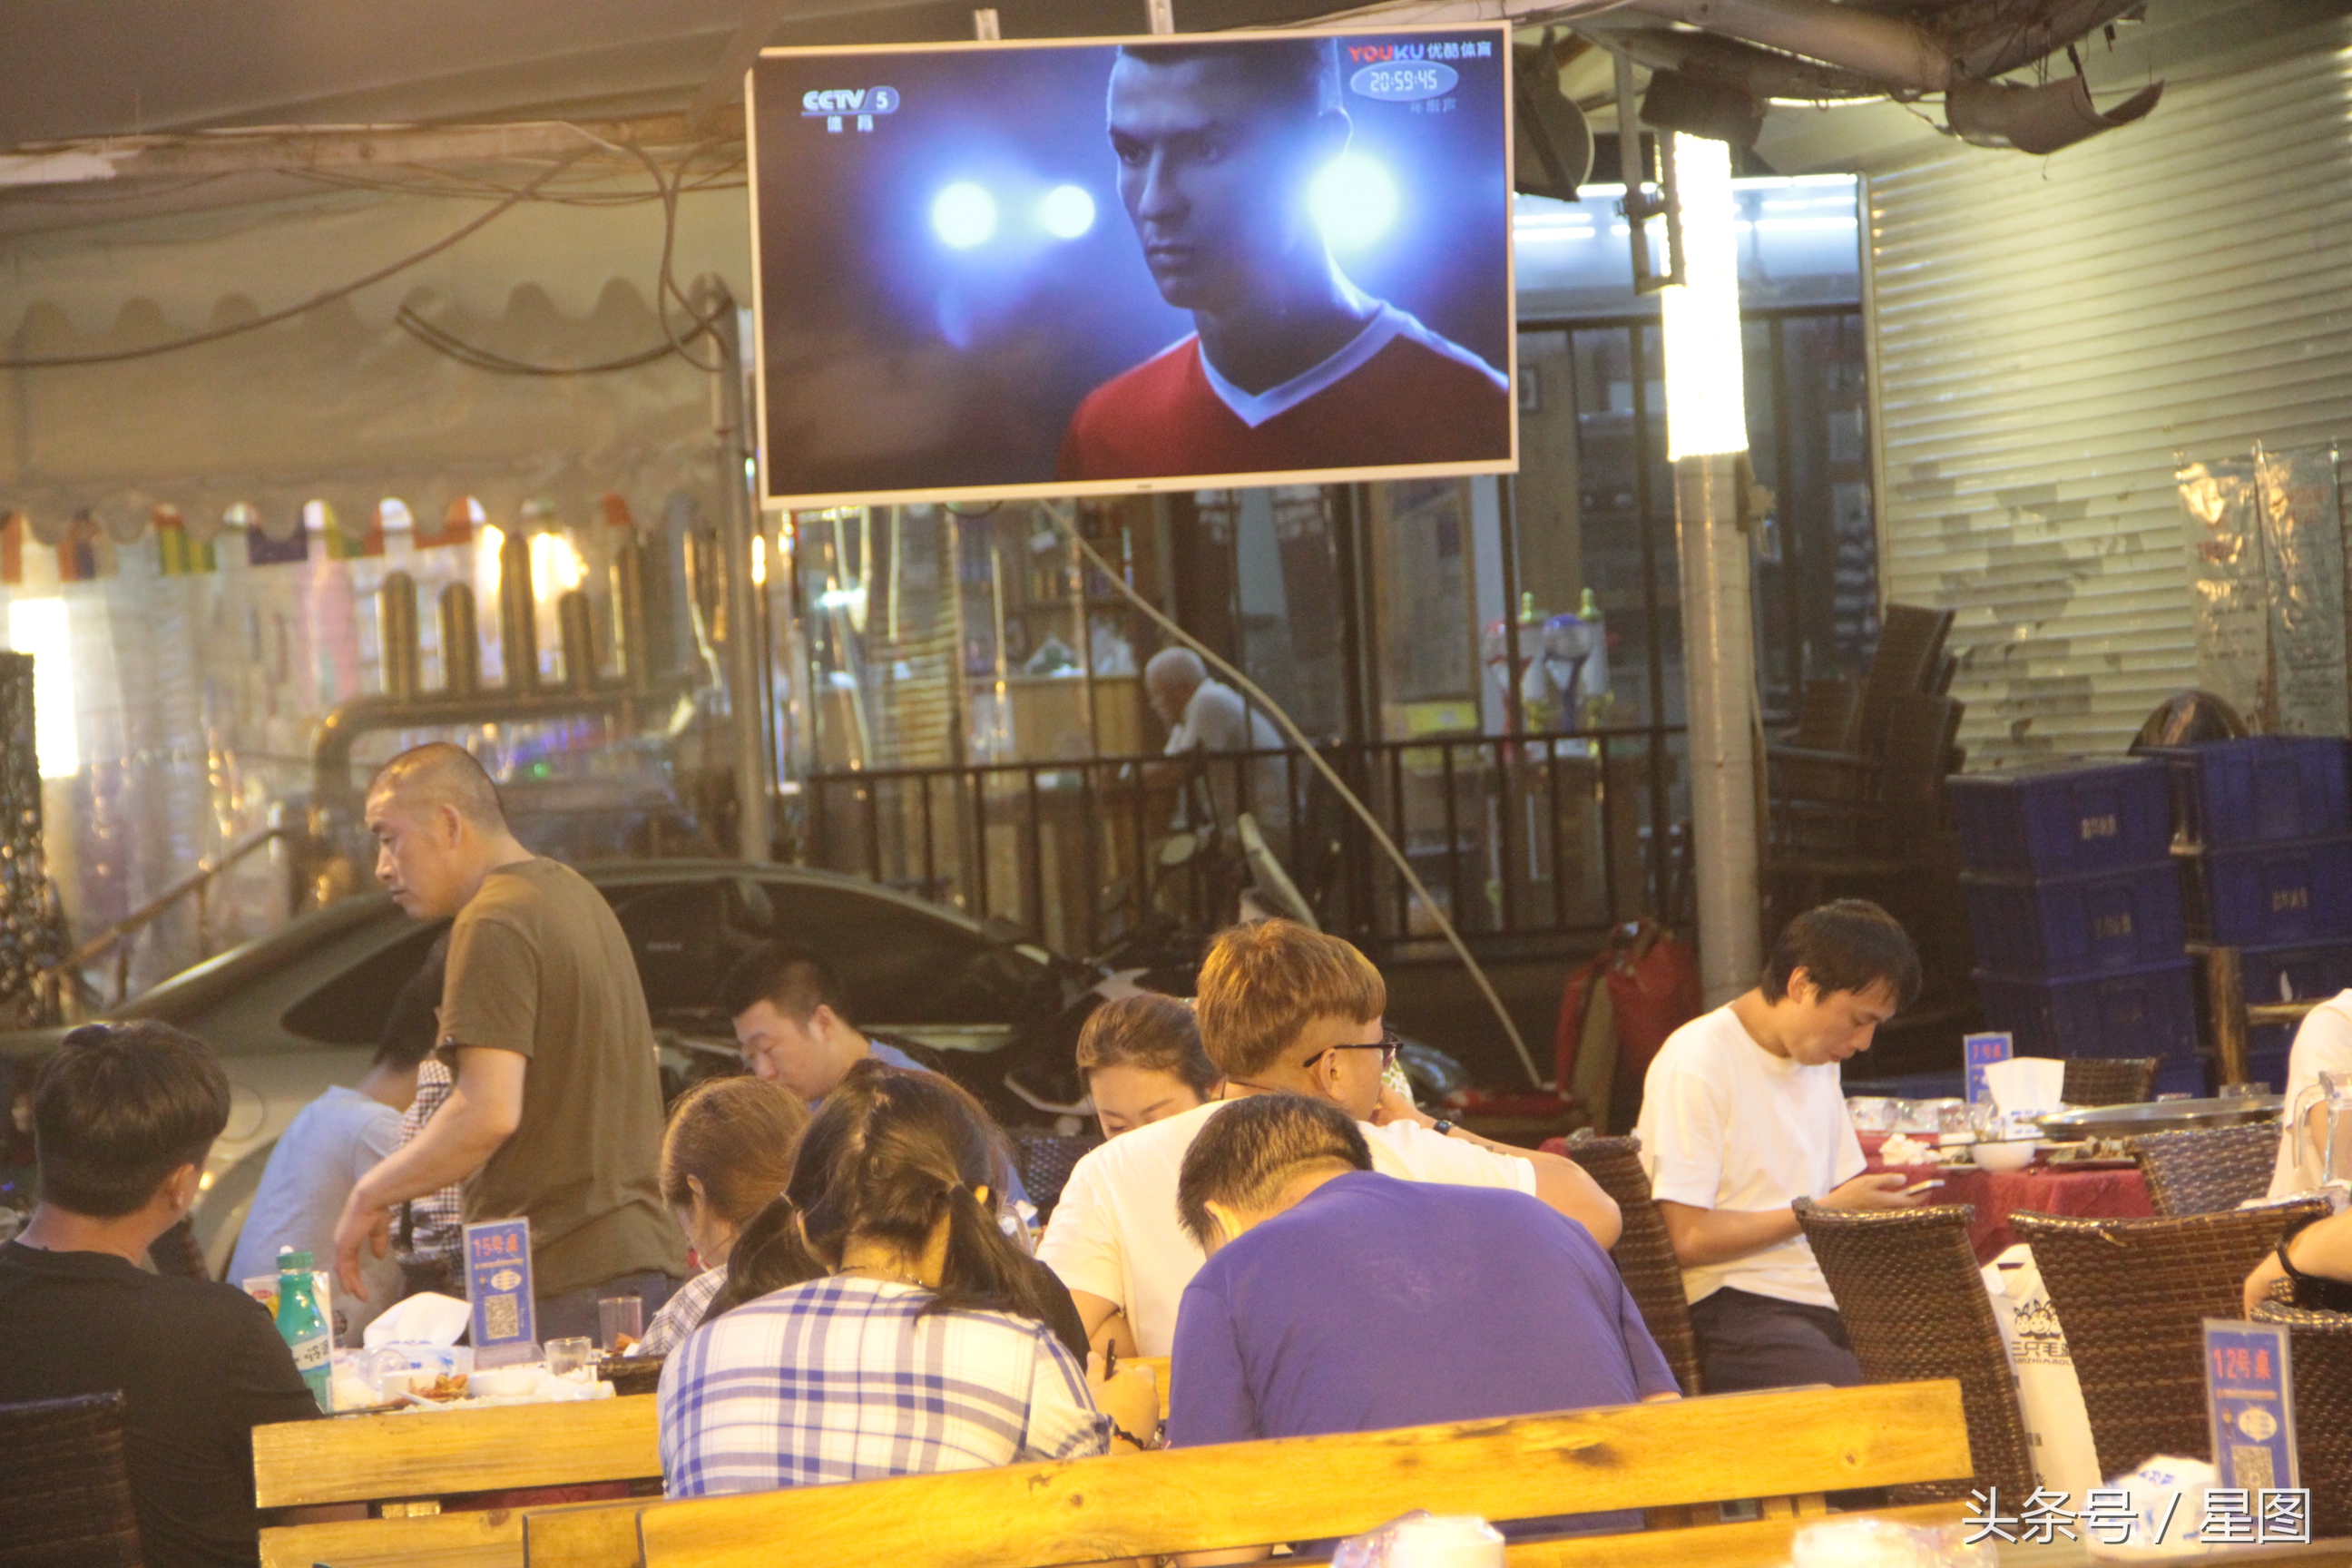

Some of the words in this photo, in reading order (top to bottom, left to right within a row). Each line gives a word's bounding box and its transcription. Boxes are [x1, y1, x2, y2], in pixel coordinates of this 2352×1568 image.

[1348, 44, 1425, 62] YOUKU
[1427, 41, 1493, 60] 优酷体育
[1370, 69, 1438, 92] 20:59:45
[802, 88, 866, 111] CCTV
[876, 91, 889, 110] 5
[473, 1233, 519, 1258] 15号桌
[2213, 1348, 2271, 1380] 12号桌
